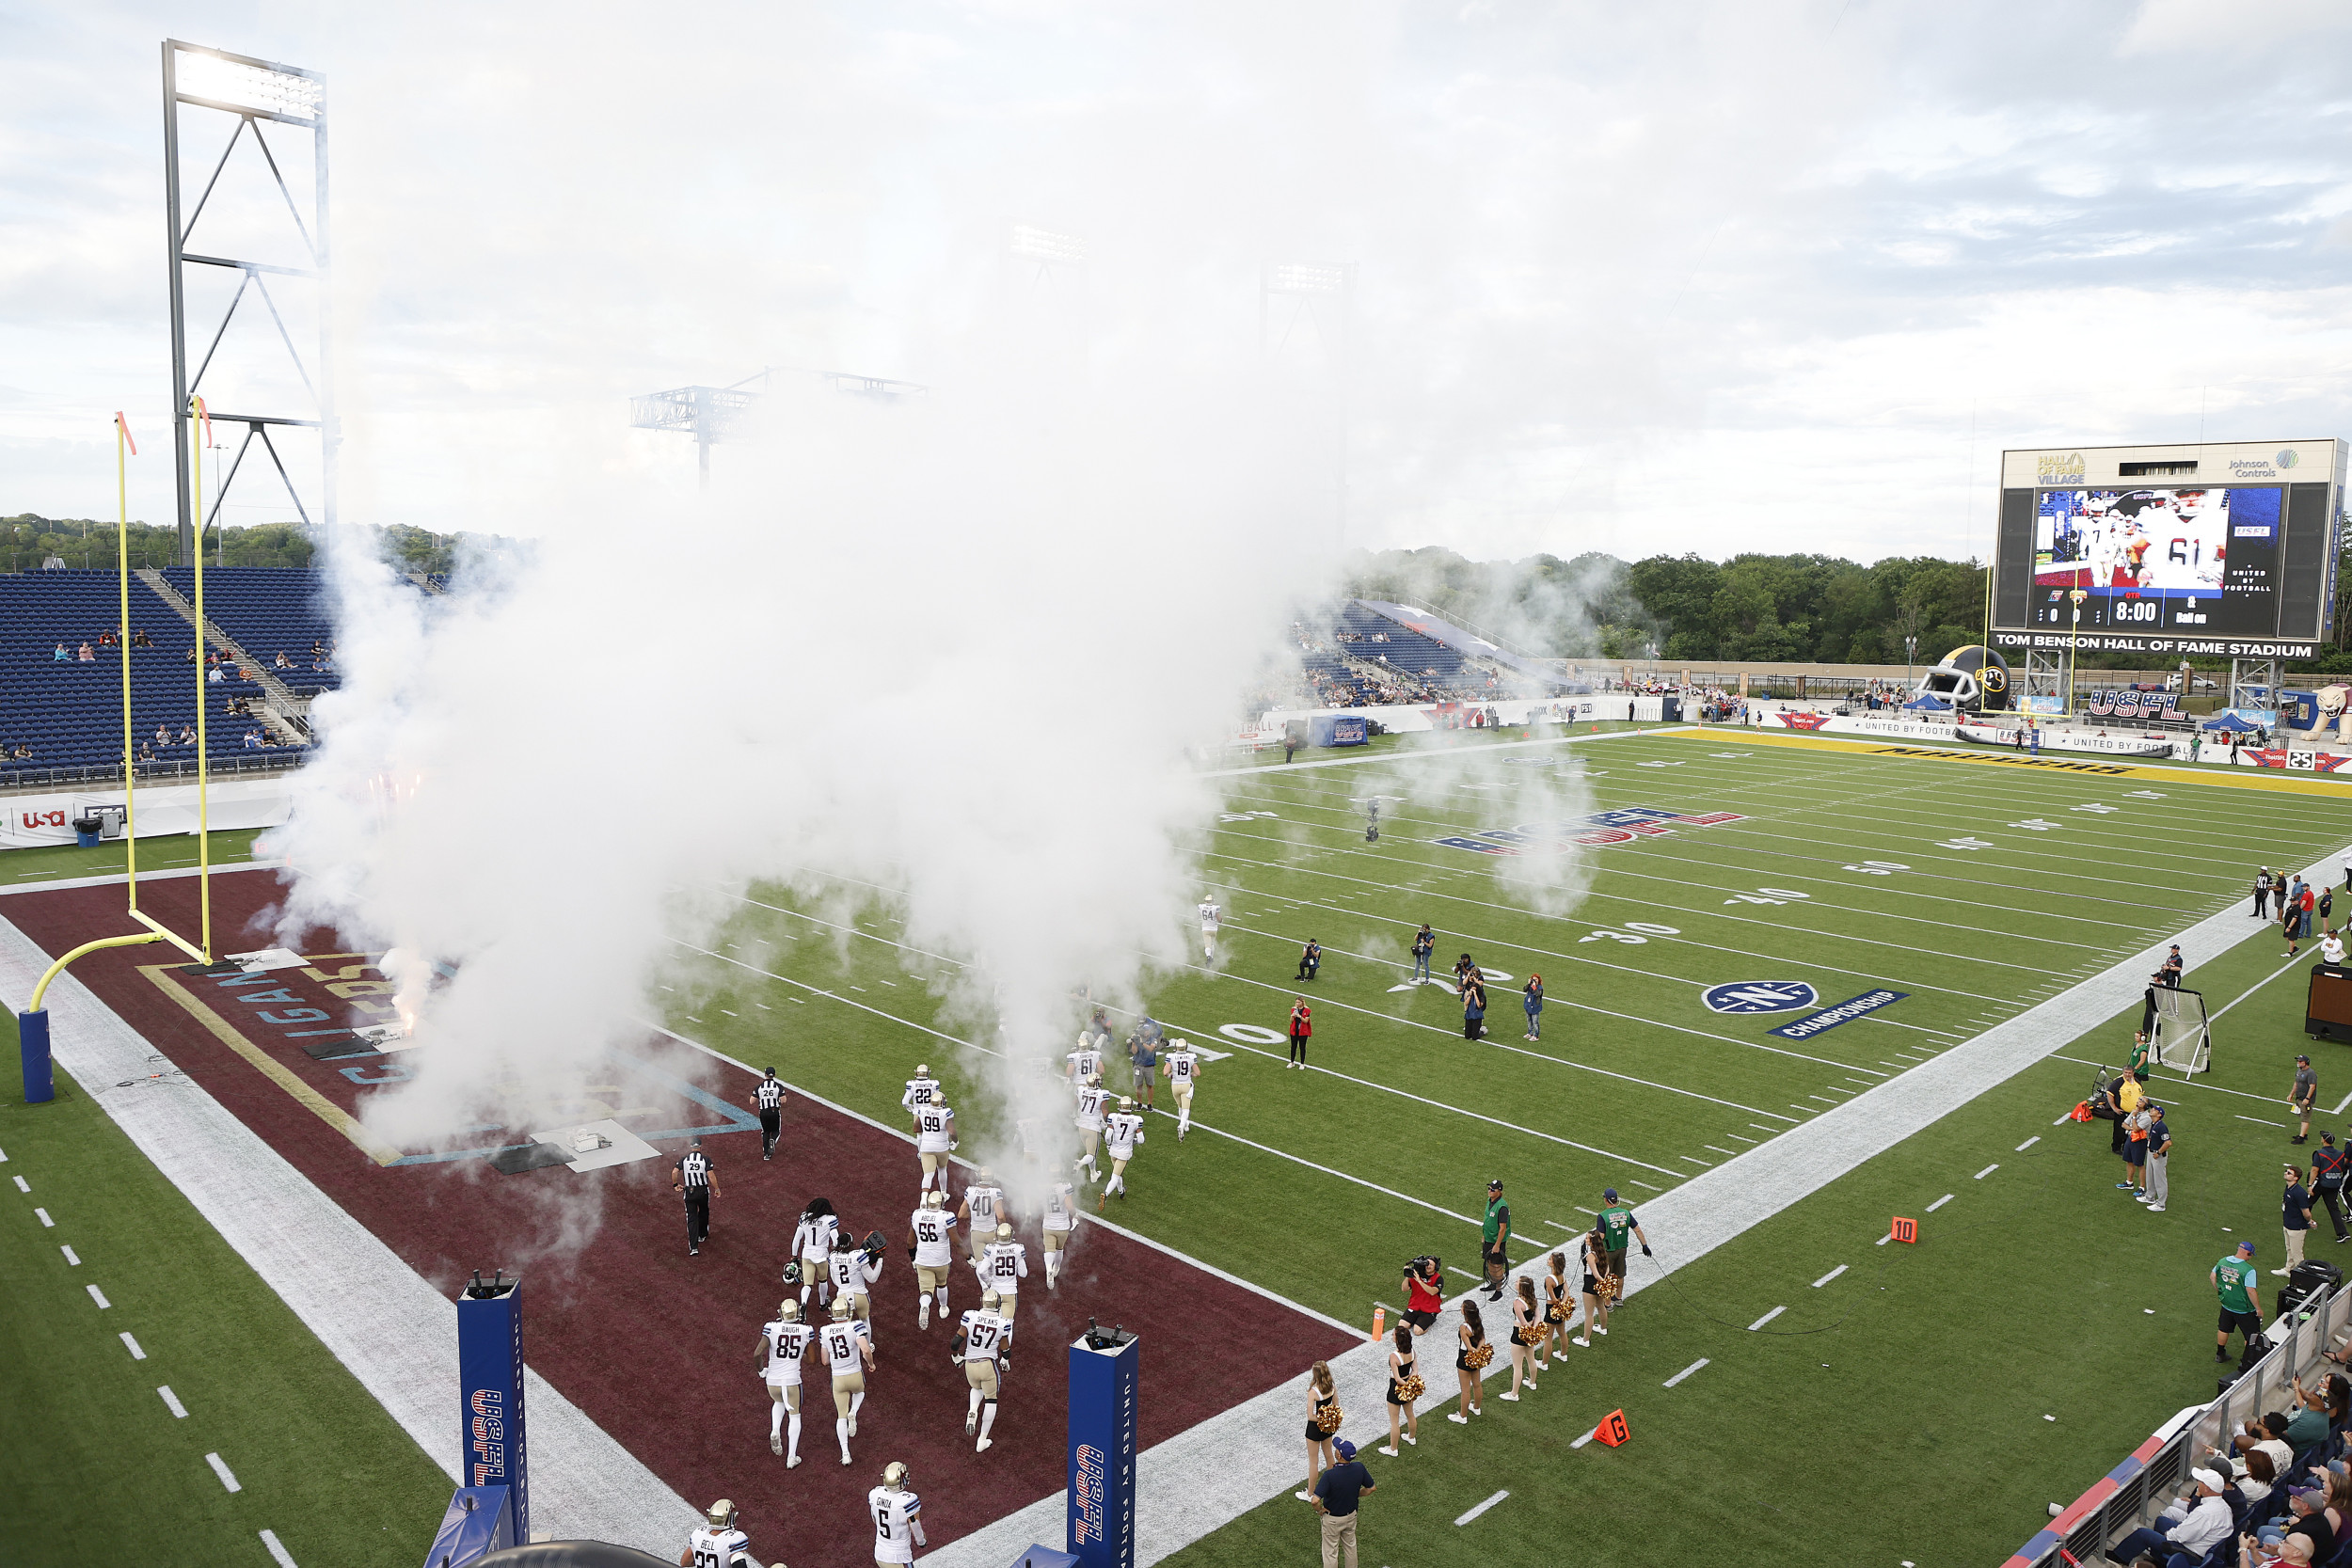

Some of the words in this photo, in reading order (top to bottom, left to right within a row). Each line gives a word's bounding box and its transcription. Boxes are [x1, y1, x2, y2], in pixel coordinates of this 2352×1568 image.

[2037, 467, 2054, 475] OF
[2056, 465, 2085, 475] FAME
[2038, 456, 2067, 466] HALL
[2229, 460, 2268, 469] Johnson
[2038, 475, 2084, 484] VILLAGE
[2235, 468, 2276, 478] Controls
[2168, 537, 2200, 566] 61
[2116, 602, 2156, 622] 8:00
[2176, 611, 2193, 624] Ball
[2194, 613, 2207, 625] on
[1996, 634, 2030, 645] TOM
[2034, 636, 2100, 649] BENSON
[2104, 638, 2145, 651] HALL
[2150, 641, 2173, 652] OF
[2177, 641, 2225, 654] FAME
[2230, 643, 2312, 657] STADIUM
[2089, 689, 2189, 721] USFL
[1866, 722, 1899, 732] UNITED
[2074, 738, 2112, 749] UNITED
[2137, 743, 2188, 754] FOOTBAL
[2291, 752, 2313, 768] 25
[23, 811, 65, 829] usa
[1429, 807, 1751, 857] USFL
[1841, 860, 1912, 876] 50
[1734, 887, 1811, 906] 40
[1201, 910, 1214, 921] 64
[1590, 922, 1681, 944] 30
[1726, 986, 1798, 1007] N
[1783, 990, 1897, 1037] CHAMPIONSHIP
[1081, 1059, 1092, 1075] 61
[1177, 1061, 1188, 1076] 19
[915, 1088, 931, 1103] 22
[1081, 1096, 1097, 1114] 77
[924, 1117, 940, 1132] 99
[1120, 1123, 1128, 1141] 7
[689, 1163, 700, 1171] 29
[972, 1196, 992, 1216] 40
[812, 1227, 816, 1245] 1
[918, 1223, 939, 1243] 56
[1897, 1220, 1913, 1240] 10
[839, 1265, 850, 1284] 2
[995, 1256, 1016, 1276] 29
[977, 1317, 997, 1325] SPEAKS
[829, 1326, 845, 1335] PERRY
[971, 1323, 997, 1349] 57
[776, 1335, 801, 1359] 85
[830, 1334, 850, 1359] 13
[1122, 1384, 1131, 1455] UNITED
[1611, 1415, 1626, 1442] G
[470, 1388, 504, 1487] USFL
[1122, 1465, 1129, 1487] BY
[877, 1497, 892, 1509] GINDA
[1075, 1444, 1104, 1545] USFL
[879, 1509, 891, 1540] 5
[701, 1540, 715, 1551] BELL
